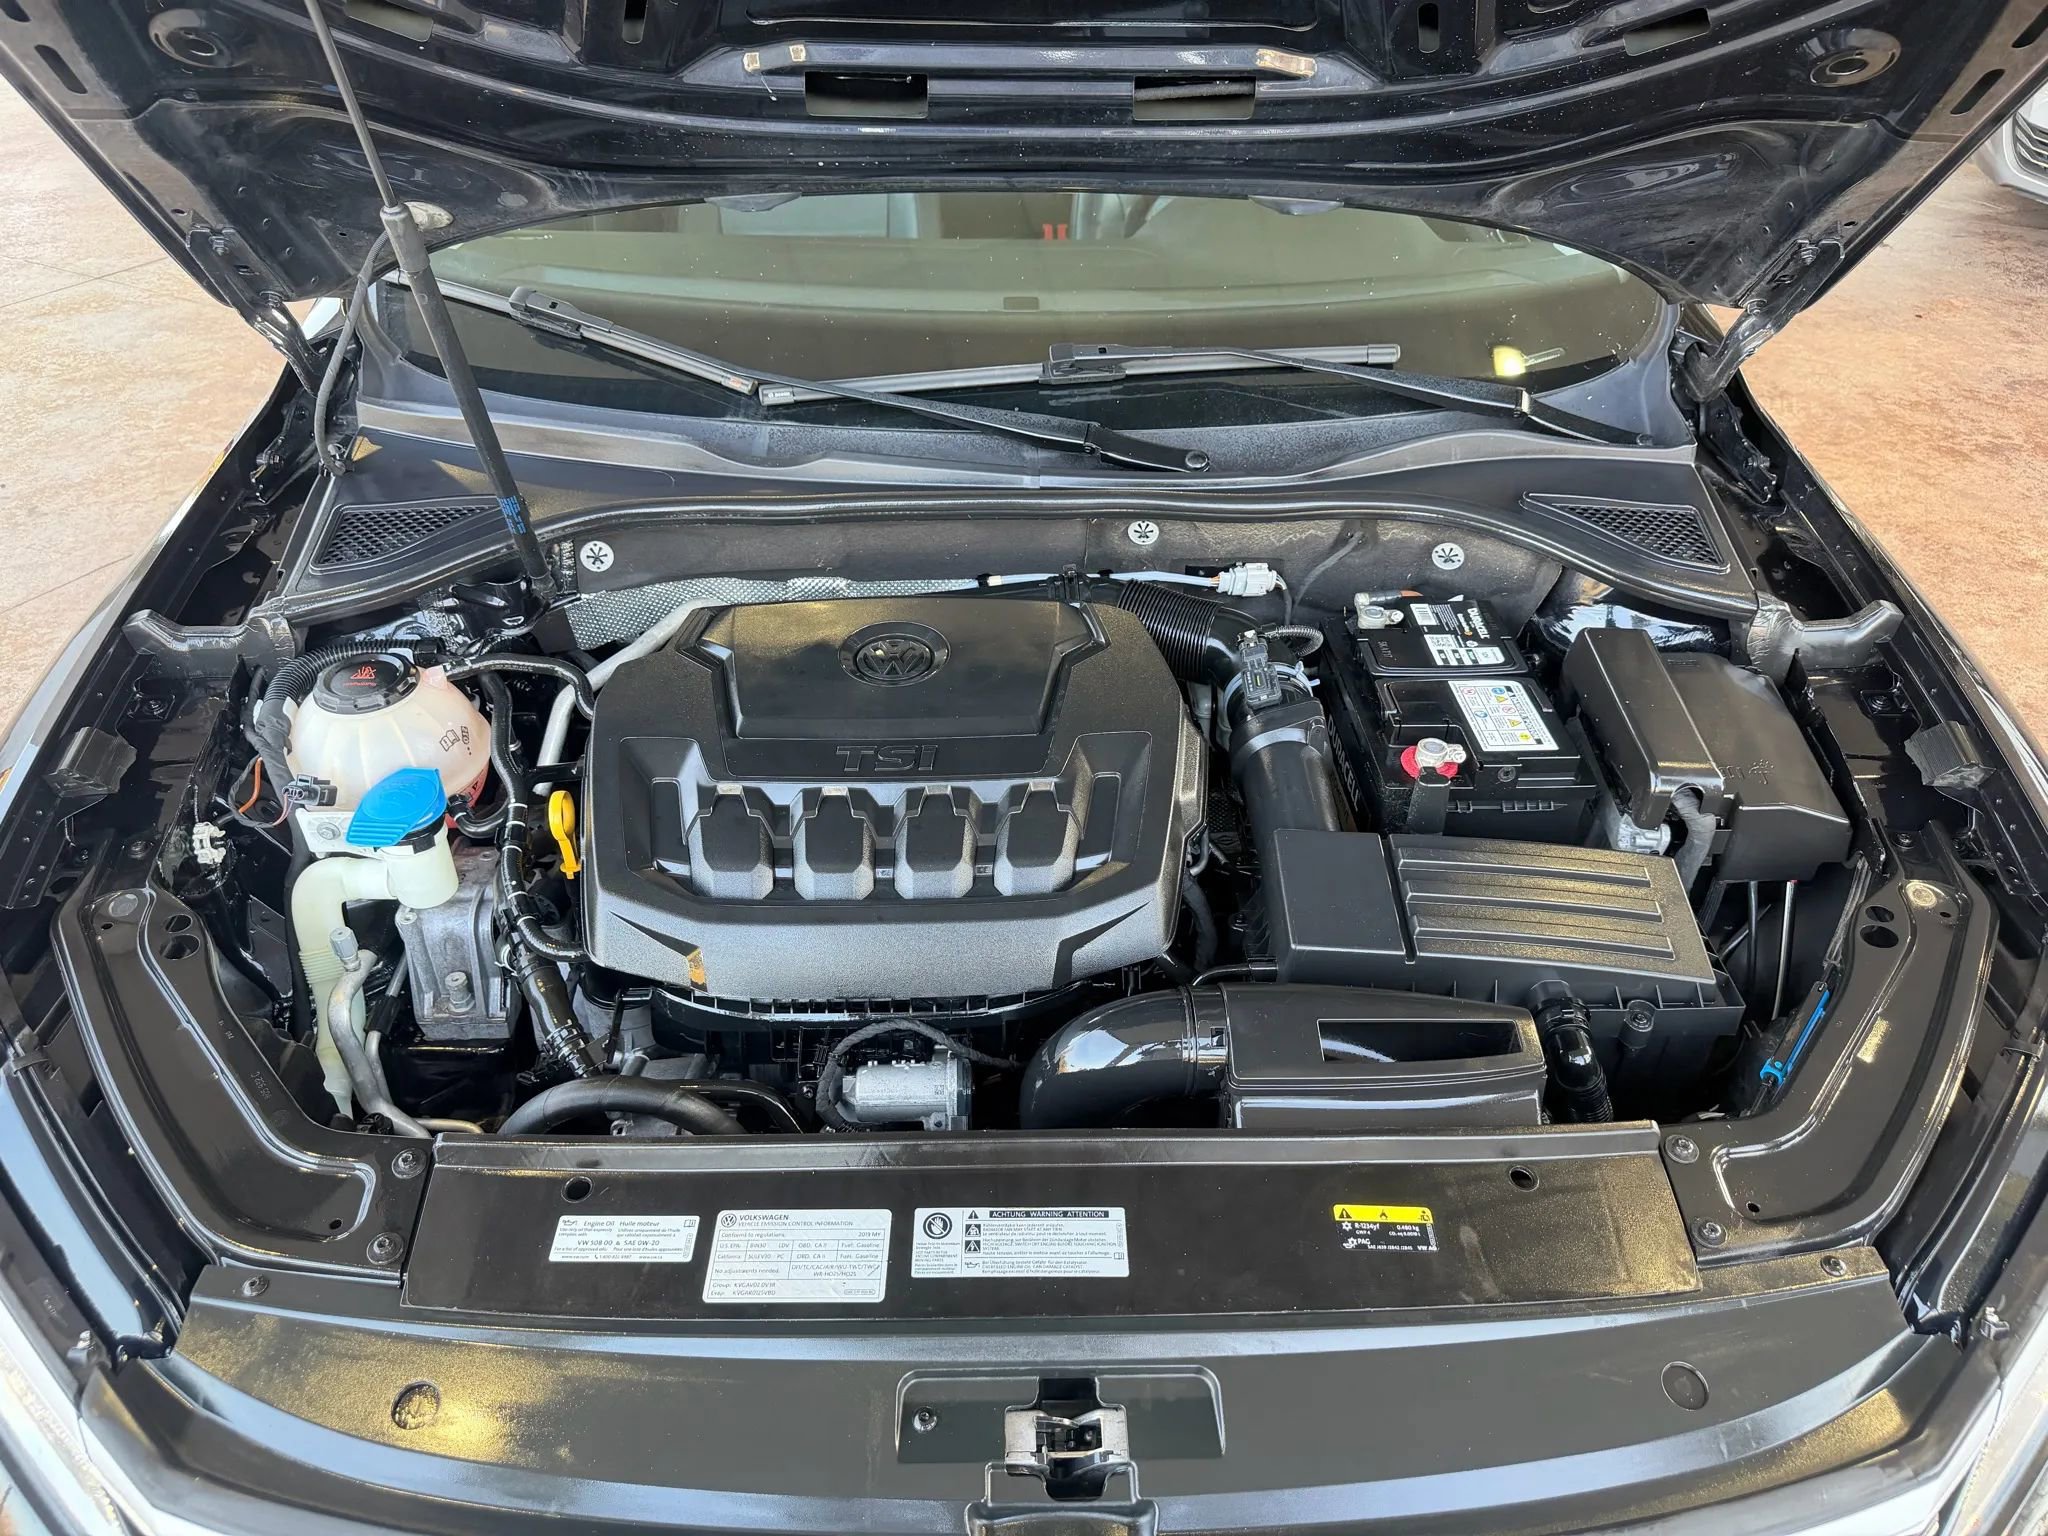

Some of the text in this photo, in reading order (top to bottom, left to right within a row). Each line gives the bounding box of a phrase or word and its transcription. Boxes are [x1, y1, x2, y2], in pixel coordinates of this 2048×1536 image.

[1467, 607, 1490, 639] DURACELL
[836, 745, 938, 772] TSI
[1354, 1223, 1380, 1231] R-1234yf
